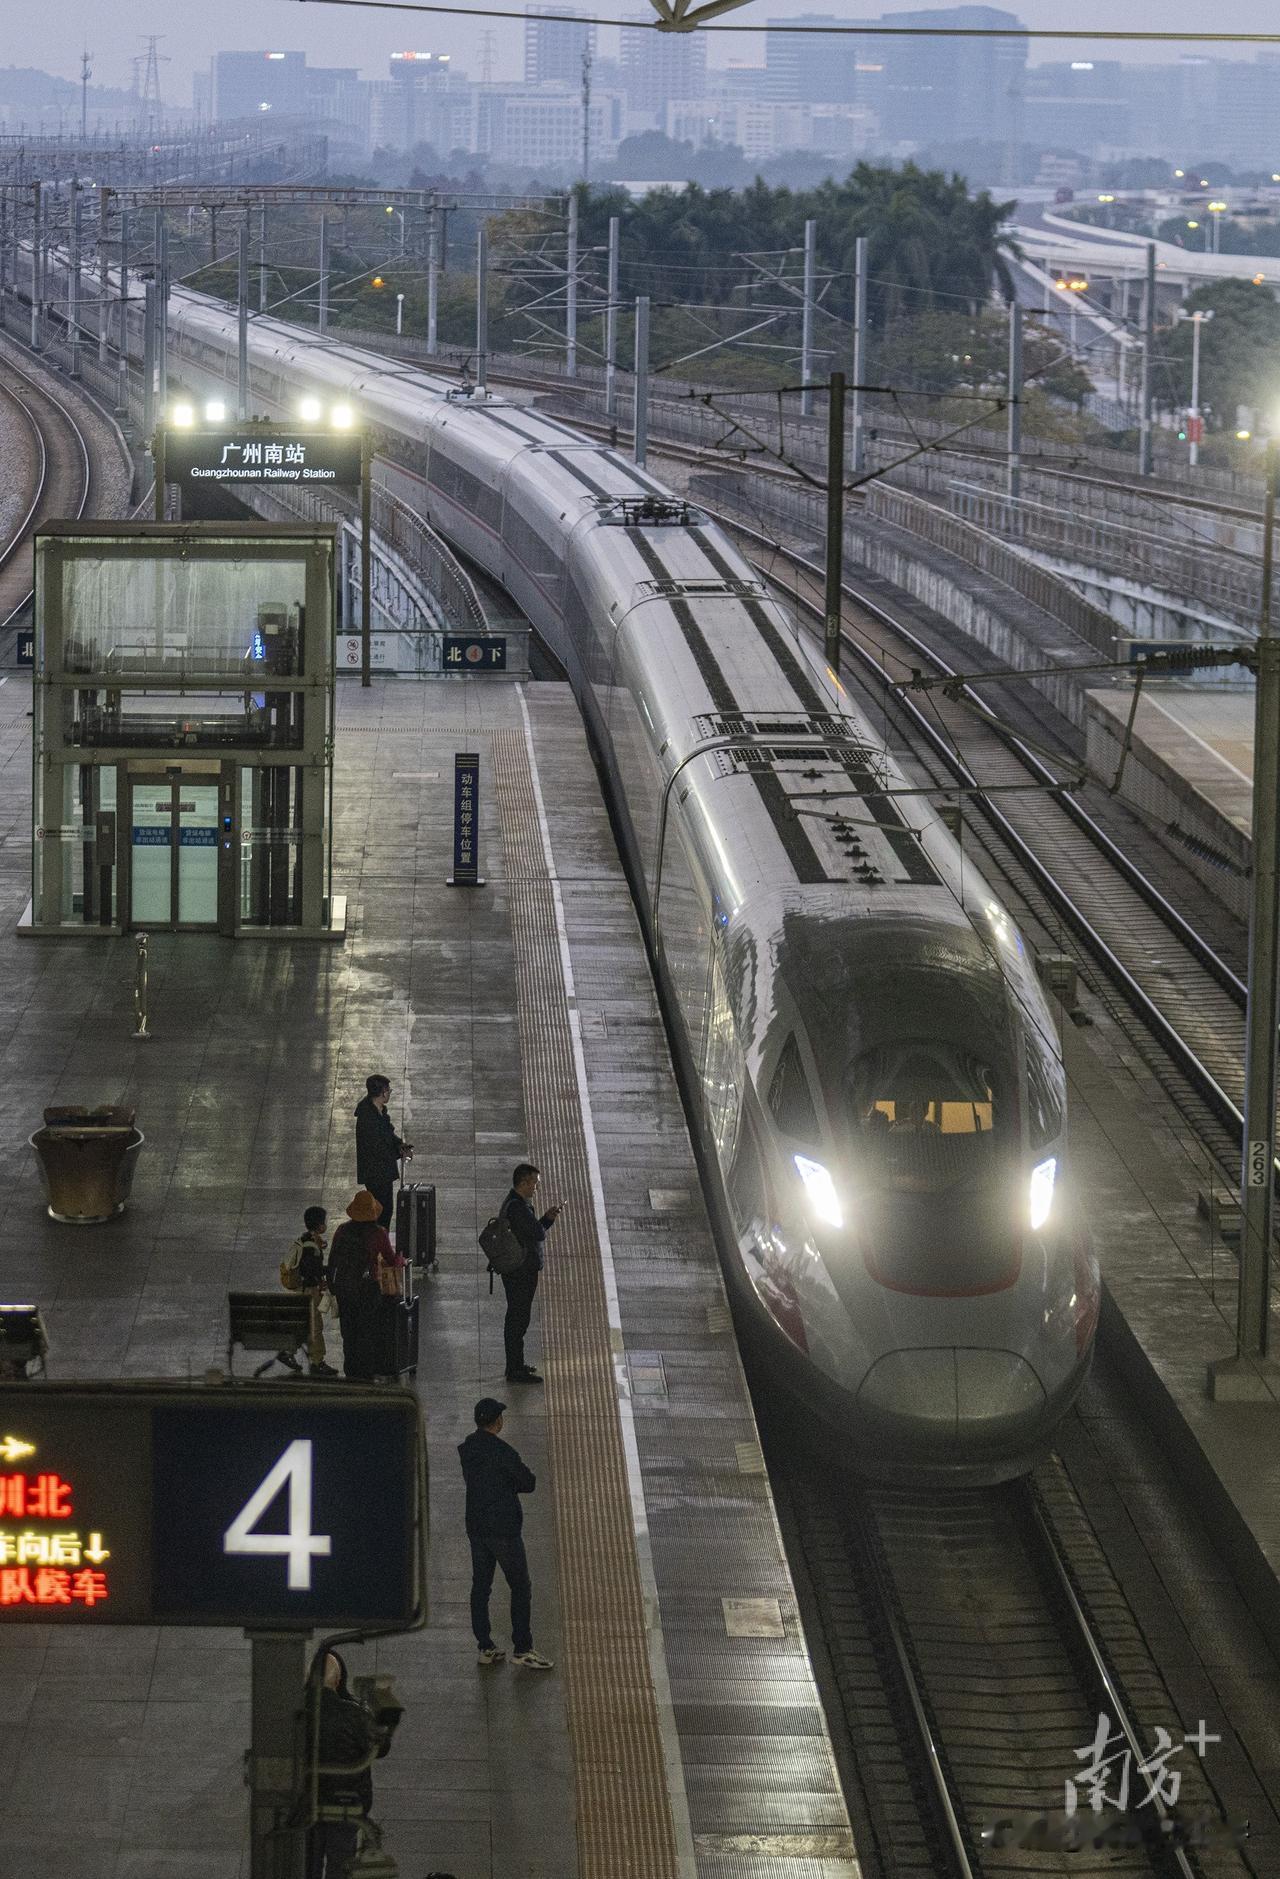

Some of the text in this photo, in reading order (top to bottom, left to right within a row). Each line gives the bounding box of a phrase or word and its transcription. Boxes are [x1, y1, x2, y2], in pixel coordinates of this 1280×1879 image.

[220, 443, 306, 464] 广州南站
[190, 467, 336, 480] Guangzhounan Railway Station
[447, 646, 462, 662] 北
[487, 647, 502, 662] 下
[460, 773, 473, 863] 动车组停车位置
[1252, 1142, 1265, 1185] 263
[223, 1439, 332, 1591] 4
